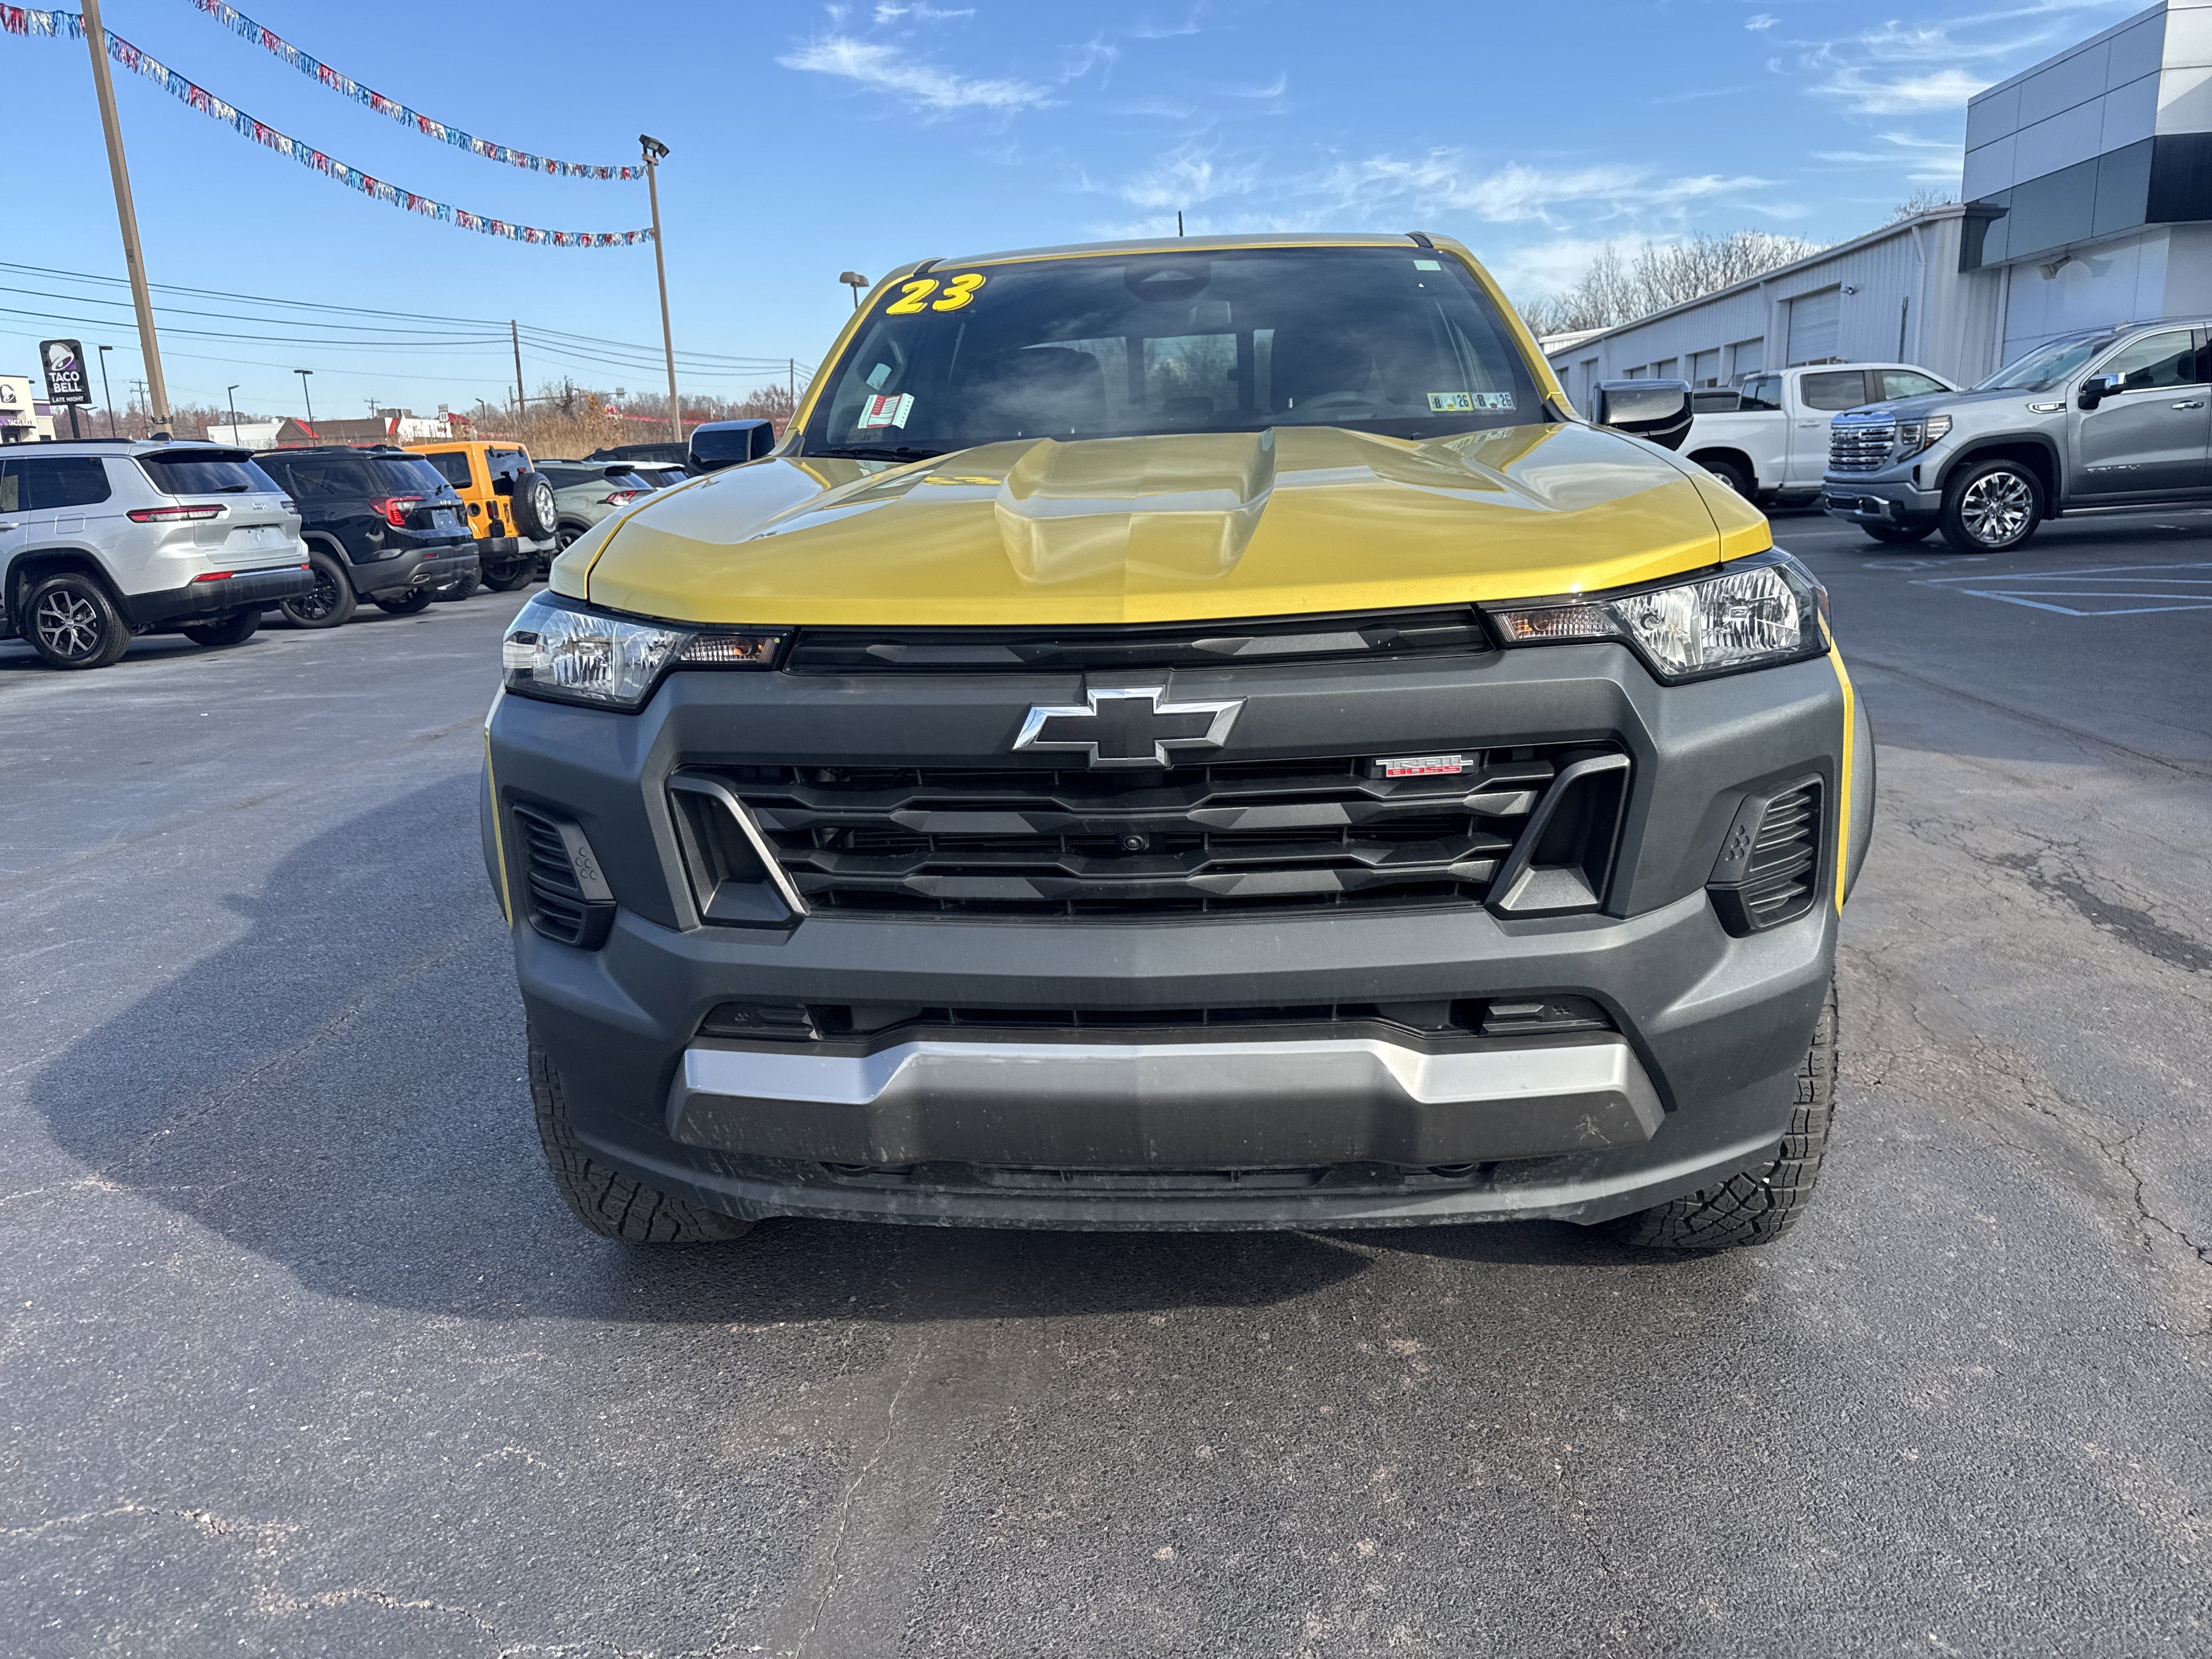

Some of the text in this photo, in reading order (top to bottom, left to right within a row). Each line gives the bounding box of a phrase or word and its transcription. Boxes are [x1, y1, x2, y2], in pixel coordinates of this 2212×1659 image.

[49, 371, 80, 382] TACO
[53, 382, 82, 393] BELL
[1457, 394, 1469, 407] 26
[1499, 394, 1511, 407] 26
[1376, 755, 1473, 769] TRAIL
[1386, 765, 1462, 777] BOSS
